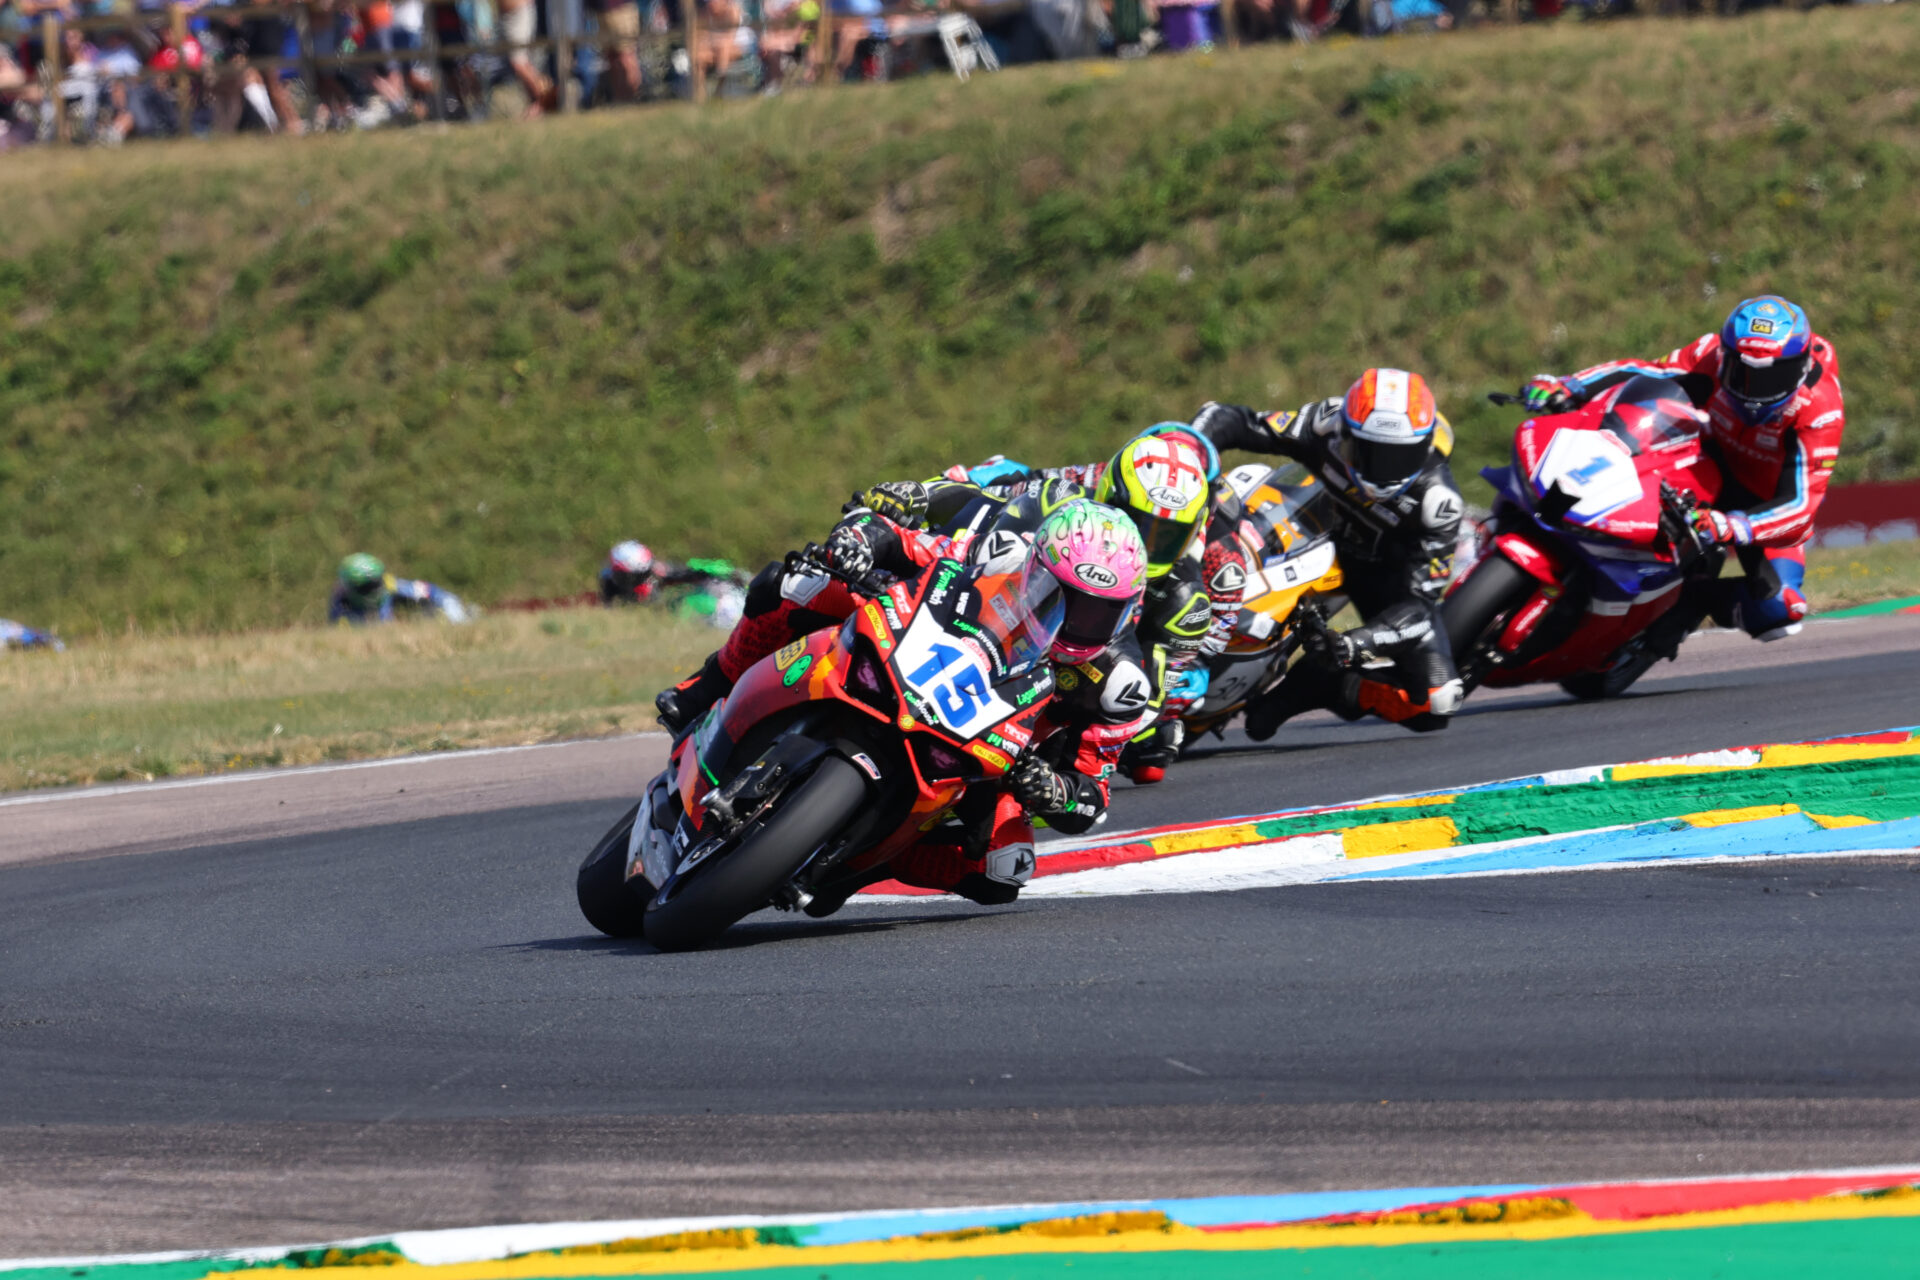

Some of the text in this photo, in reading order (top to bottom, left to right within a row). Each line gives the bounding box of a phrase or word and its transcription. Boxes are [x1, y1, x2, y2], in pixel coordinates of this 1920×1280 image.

[1566, 455, 1615, 486] 1
[1150, 487, 1184, 505] Arai
[1076, 566, 1114, 585] Arai
[906, 643, 992, 729] 15
